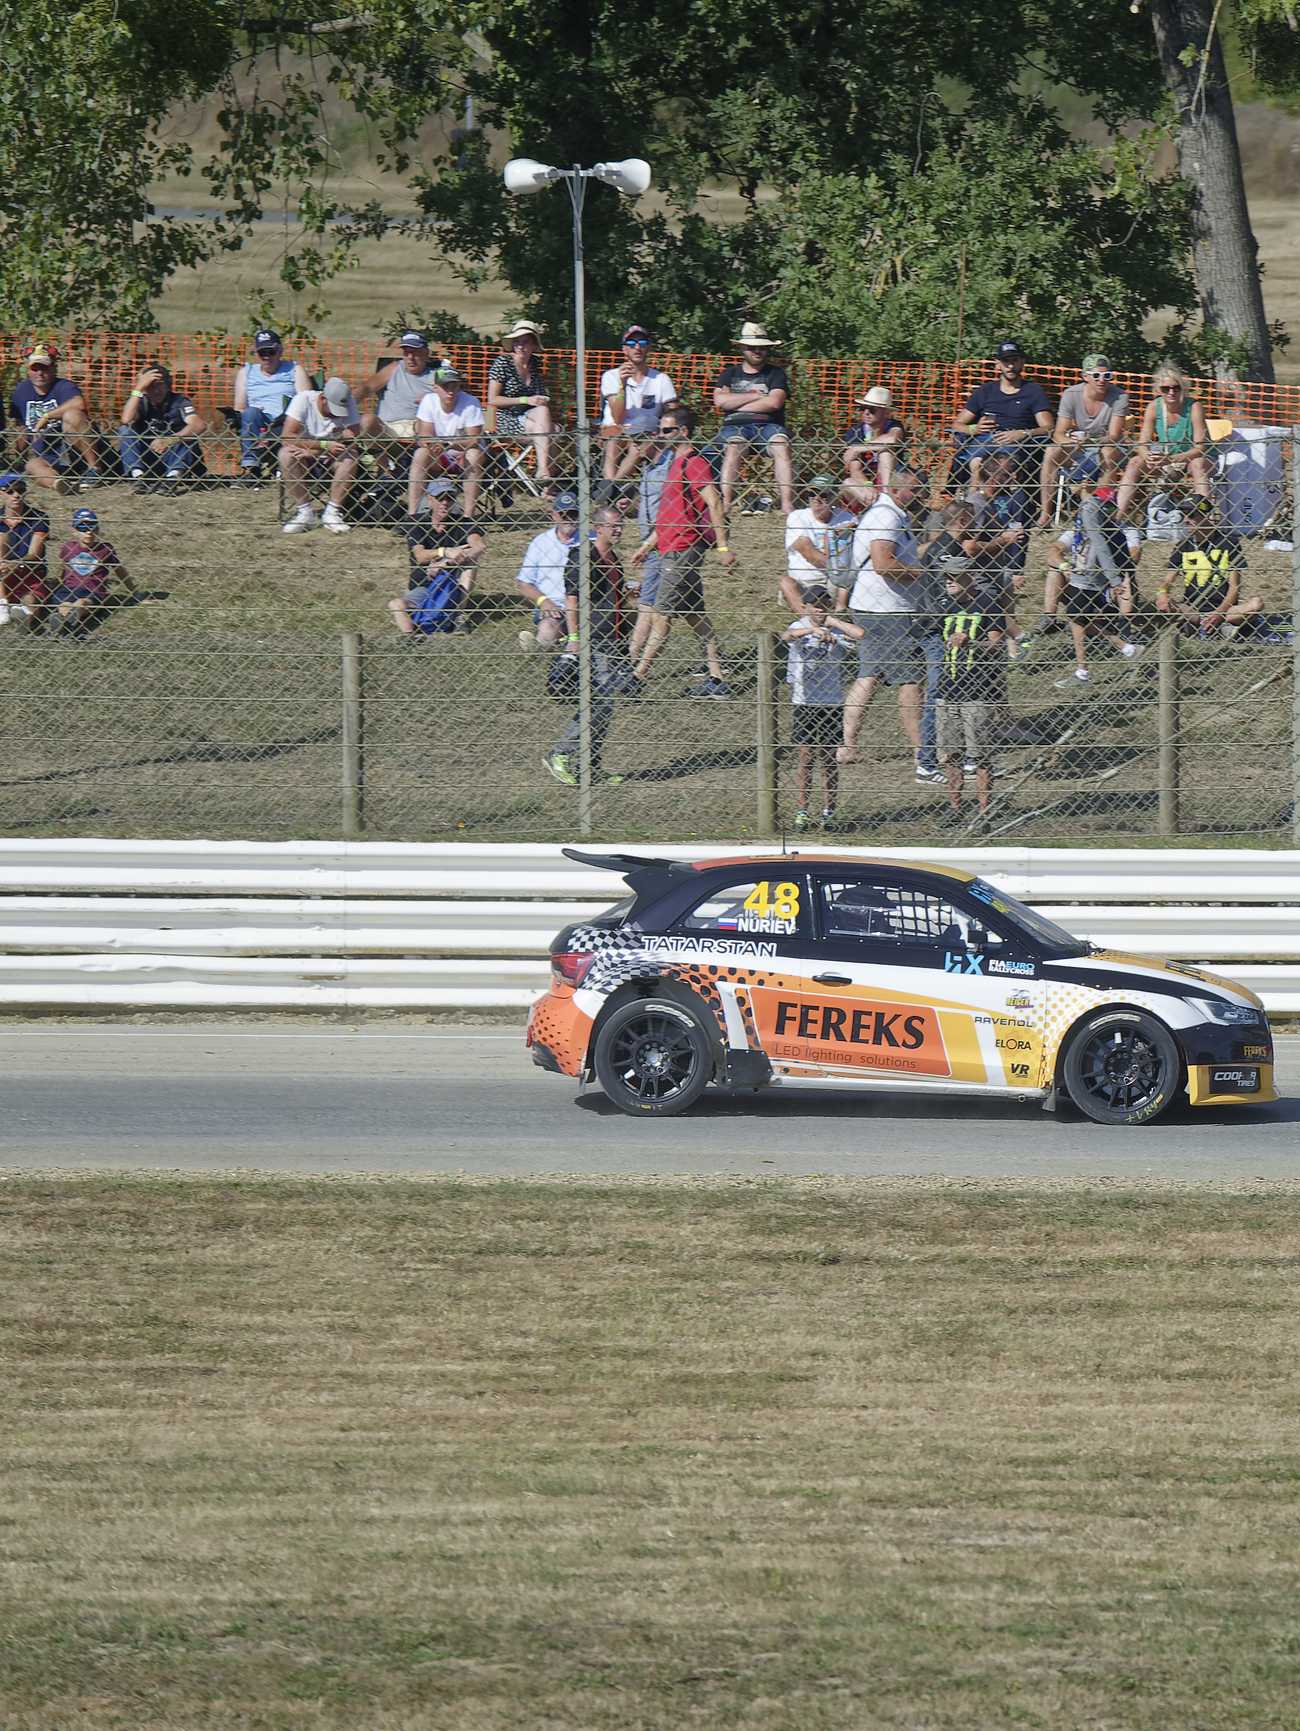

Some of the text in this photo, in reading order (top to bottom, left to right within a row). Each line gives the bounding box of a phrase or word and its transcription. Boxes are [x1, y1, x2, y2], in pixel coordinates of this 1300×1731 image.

[744, 881, 800, 919] 48
[738, 918, 797, 935] NURIEV
[641, 936, 777, 958] TATARSTAN
[775, 1001, 925, 1050] FEREKS
[974, 1016, 1033, 1028] RAVENOL
[995, 1038, 1032, 1051] ELORA
[775, 1043, 917, 1069] LED lighting solutions
[1010, 1063, 1030, 1075] VR
[1214, 1072, 1257, 1080] COOR
